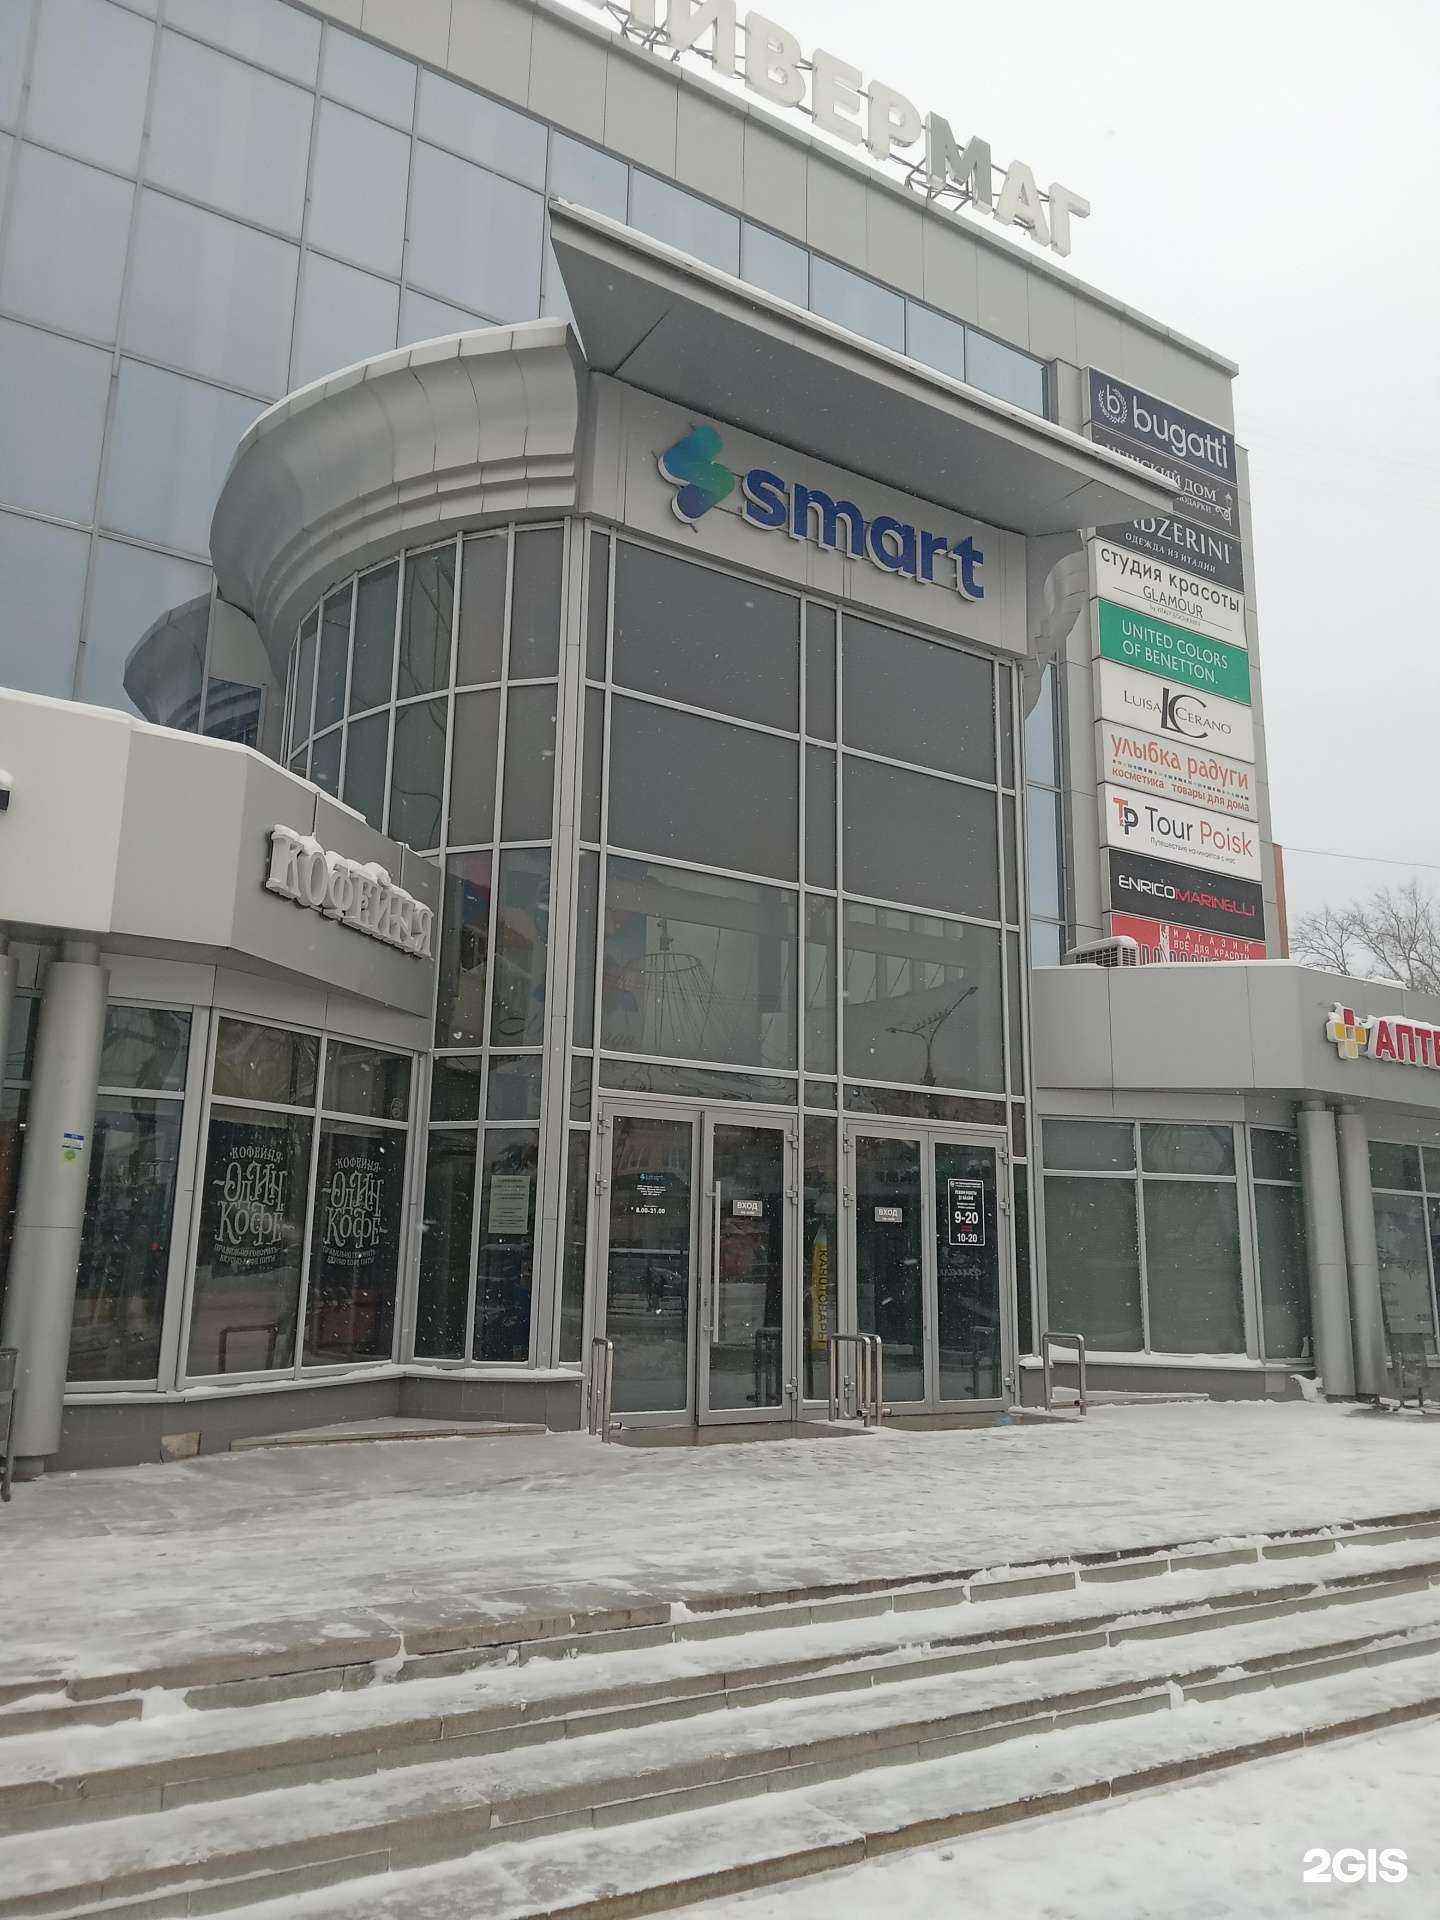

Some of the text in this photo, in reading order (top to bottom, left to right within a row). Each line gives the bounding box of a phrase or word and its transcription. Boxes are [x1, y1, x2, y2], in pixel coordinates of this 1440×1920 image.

[1132, 396, 1228, 469] bugatti
[1184, 478, 1217, 501] ДОМ
[743, 468, 984, 602] smart
[1167, 548, 1179, 559] ИЗ
[1143, 585, 1203, 618] GLAMOUR
[1169, 573, 1239, 612] красоты
[1122, 620, 1228, 669] UNITED COLORS
[1122, 641, 1141, 656] OF
[1111, 734, 1249, 790] улыбка радуги
[1112, 768, 1250, 812] косметика товары для дома
[1144, 806, 1194, 841] Tour
[1200, 820, 1254, 857] Poisk
[1194, 944, 1209, 955] ДЛЯ
[737, 1202, 758, 1211] ВХОД
[878, 1209, 898, 1217] ВХОД
[954, 1211, 979, 1224] 9-20
[957, 1233, 978, 1243] 10-20
